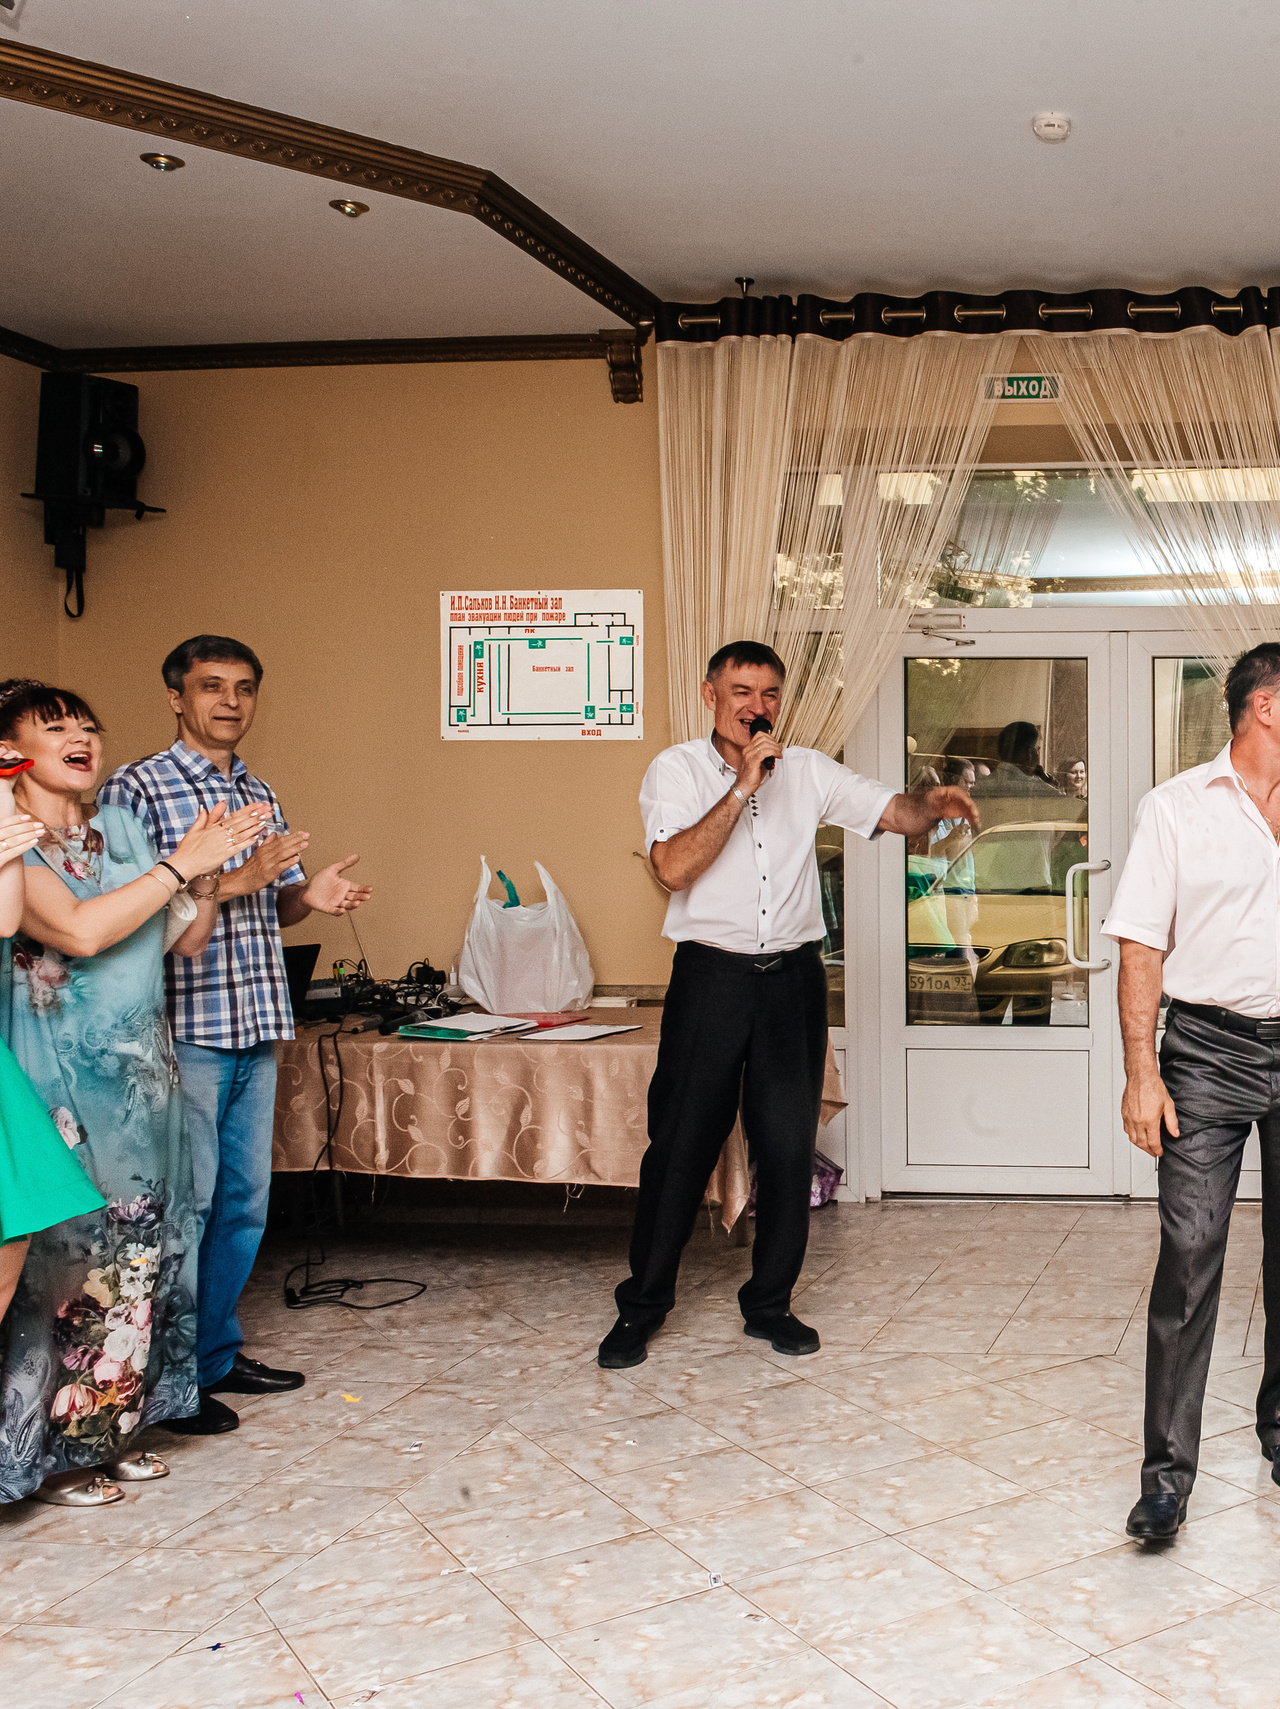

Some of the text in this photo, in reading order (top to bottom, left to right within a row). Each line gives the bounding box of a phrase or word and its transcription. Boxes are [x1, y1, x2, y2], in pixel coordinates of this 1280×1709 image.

[993, 379, 1051, 398] ВЫХОД
[550, 596, 563, 610] зал
[450, 611, 566, 625] план эвакуации людей при пожаре
